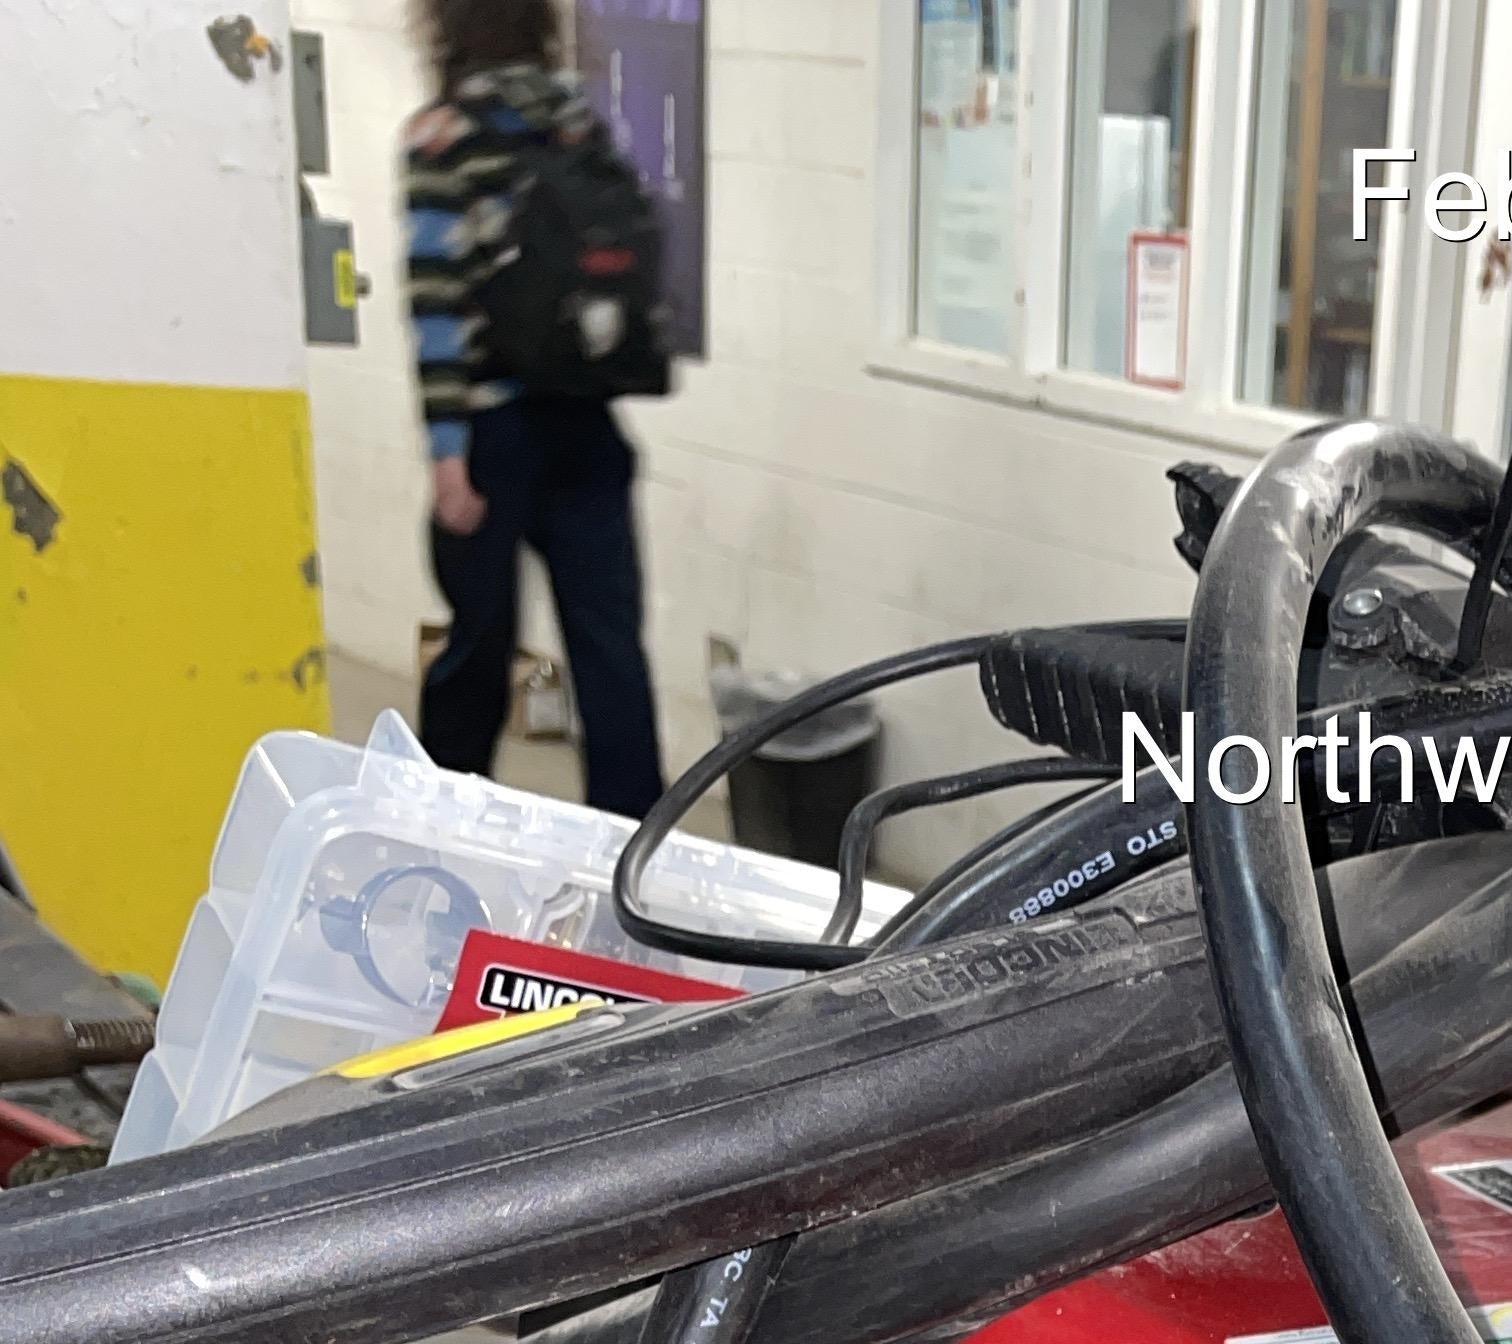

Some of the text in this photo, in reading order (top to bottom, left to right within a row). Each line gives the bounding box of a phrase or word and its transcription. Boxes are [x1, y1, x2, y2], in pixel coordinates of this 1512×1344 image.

[1009, 819, 1177, 926] STO E300888
[699, 1296, 729, 1328] TA
